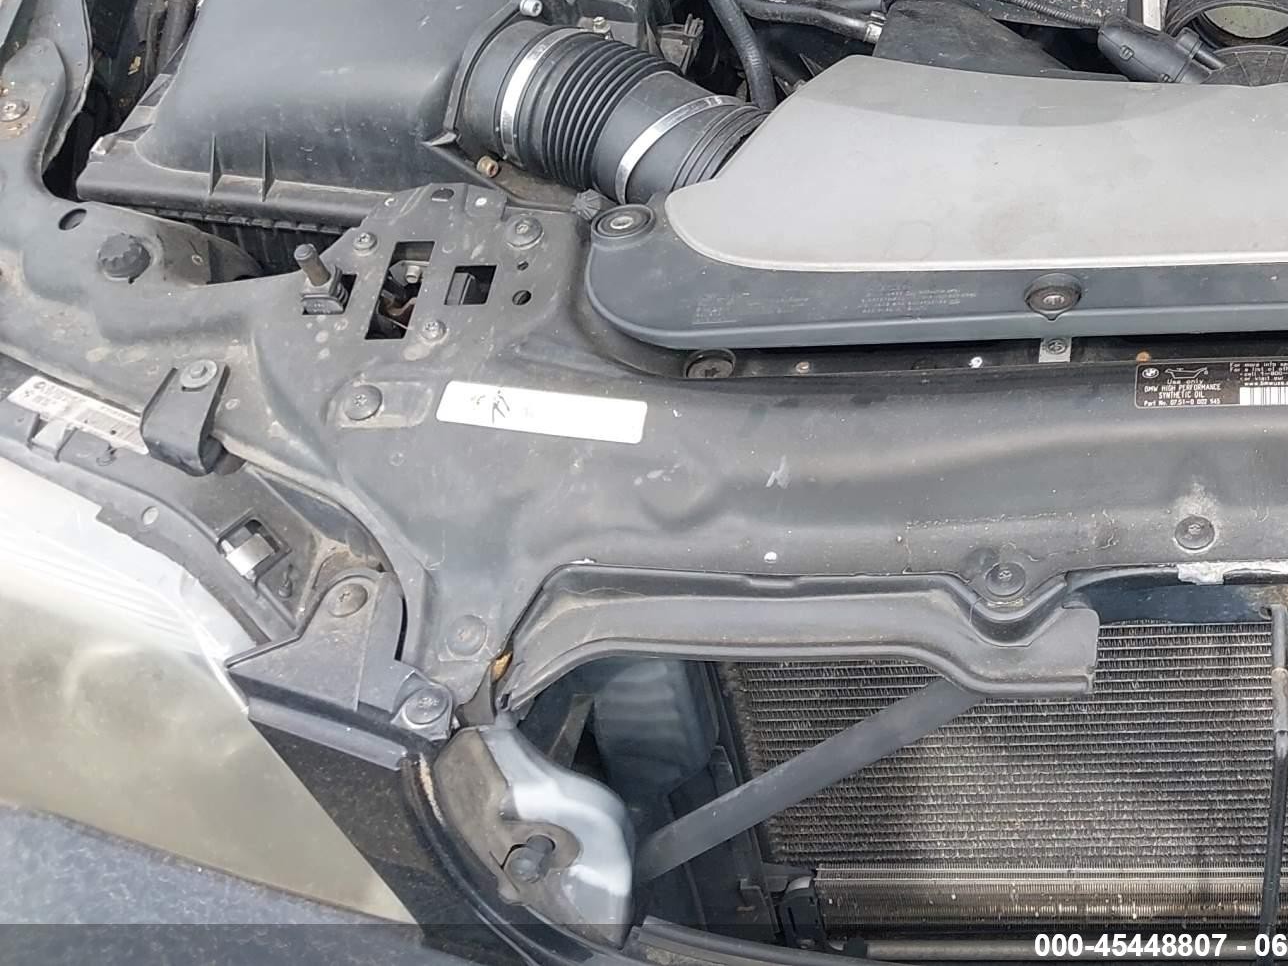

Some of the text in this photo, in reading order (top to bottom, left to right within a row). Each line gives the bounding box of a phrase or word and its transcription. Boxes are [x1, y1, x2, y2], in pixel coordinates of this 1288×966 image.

[1161, 384, 1176, 392] HIGH
[1179, 383, 1221, 391] PERFORMANCE
[1158, 391, 1191, 399] SYNTHETIC
